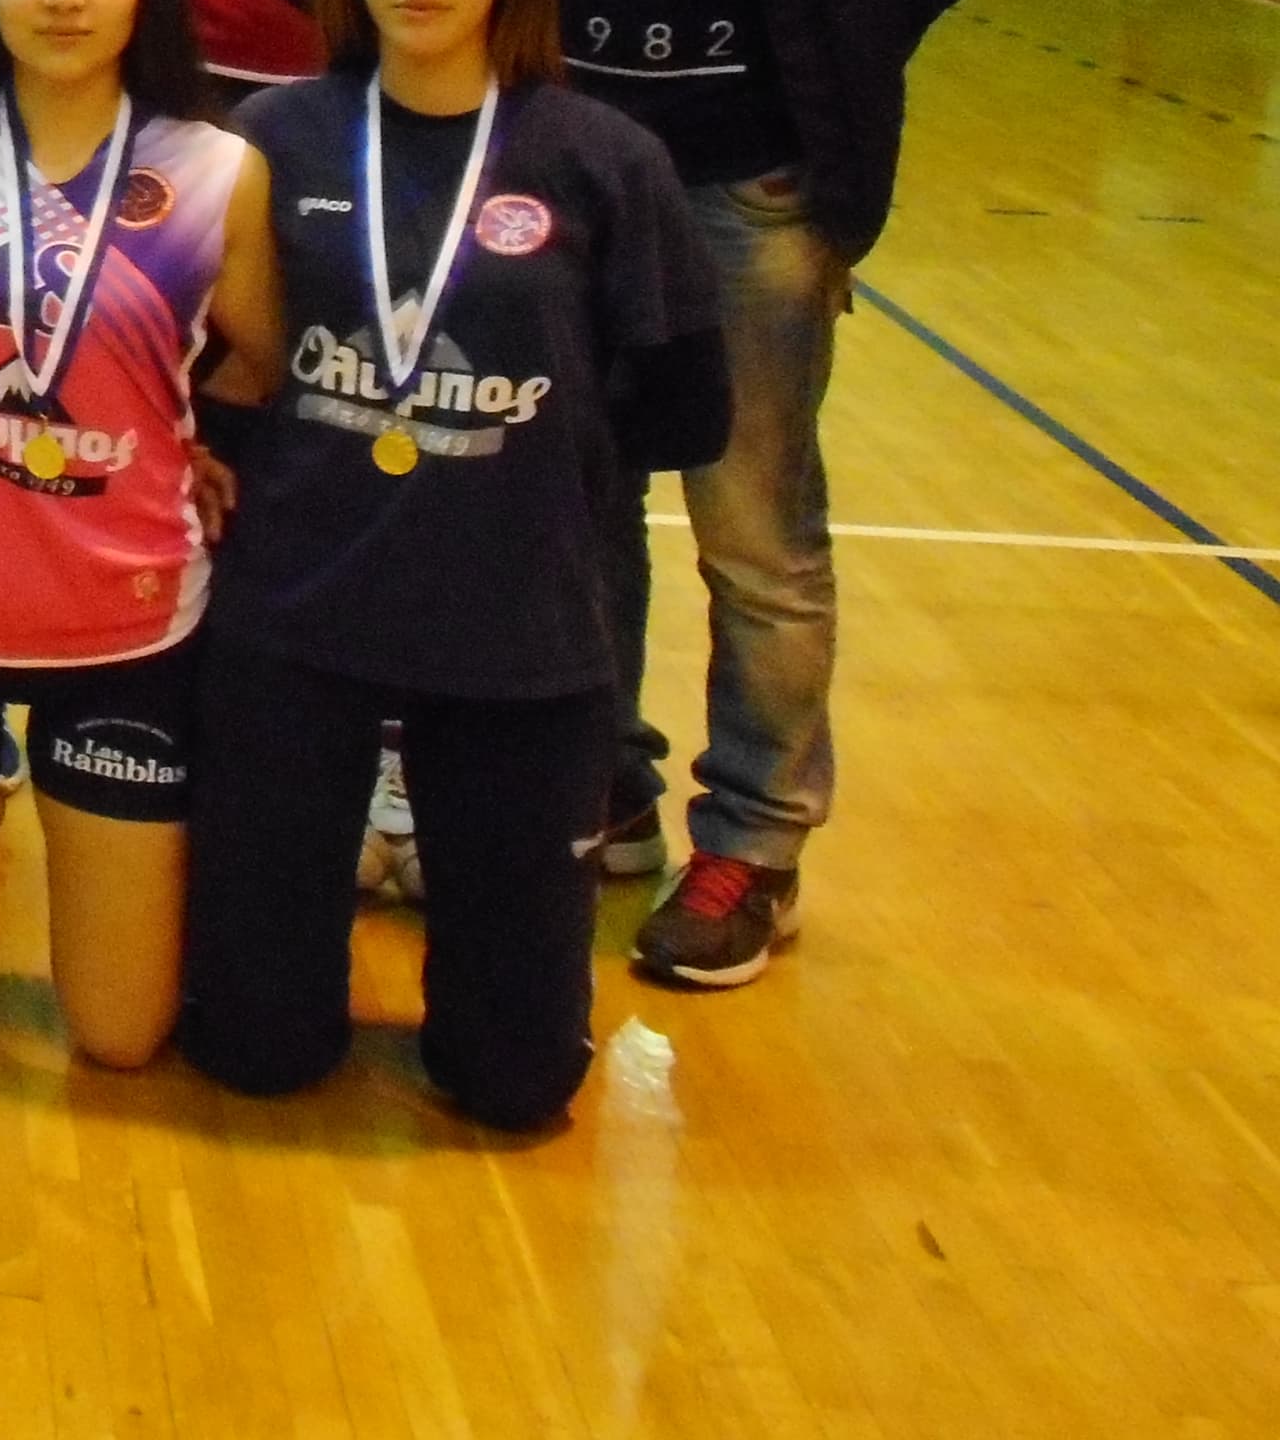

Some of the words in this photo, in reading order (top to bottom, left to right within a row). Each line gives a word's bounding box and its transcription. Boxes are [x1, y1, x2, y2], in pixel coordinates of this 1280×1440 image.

[587, 16, 735, 60] 982
[52, 737, 188, 785] Ramblas
[85, 738, 123, 761] Las
